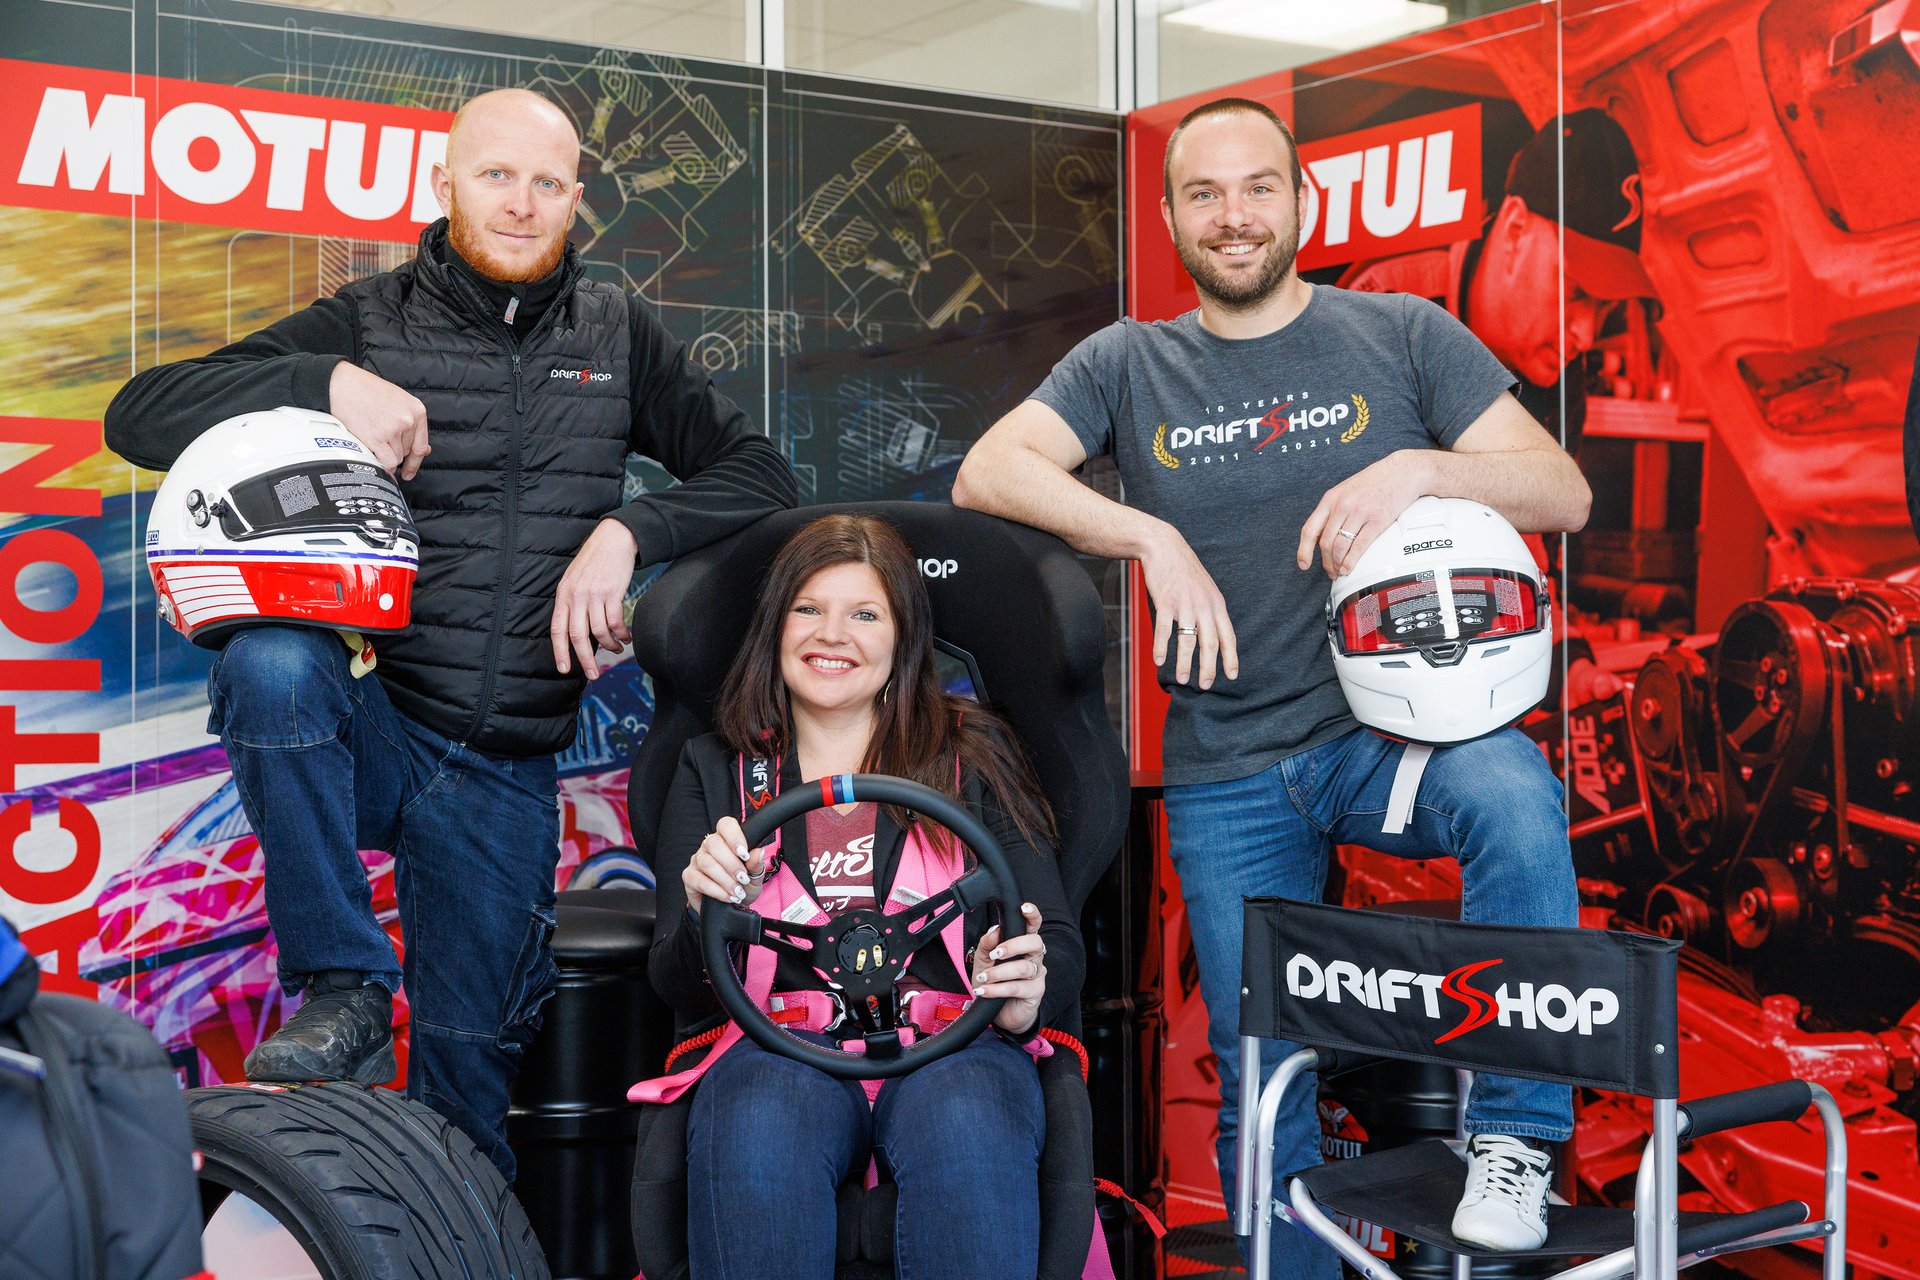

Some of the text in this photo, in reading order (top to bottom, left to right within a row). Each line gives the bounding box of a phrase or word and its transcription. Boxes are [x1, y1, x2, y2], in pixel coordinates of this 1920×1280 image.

[550, 368, 612, 384] DRIFTSHOP
[1205, 391, 1309, 415] 10 YEARS
[1170, 401, 1349, 451] DRIFTSHOP
[1190, 453, 1239, 465] 2011
[1281, 437, 1331, 453] 2021
[1403, 539, 1453, 554] sparco
[1285, 952, 1620, 1044] DRIFTSHOP
